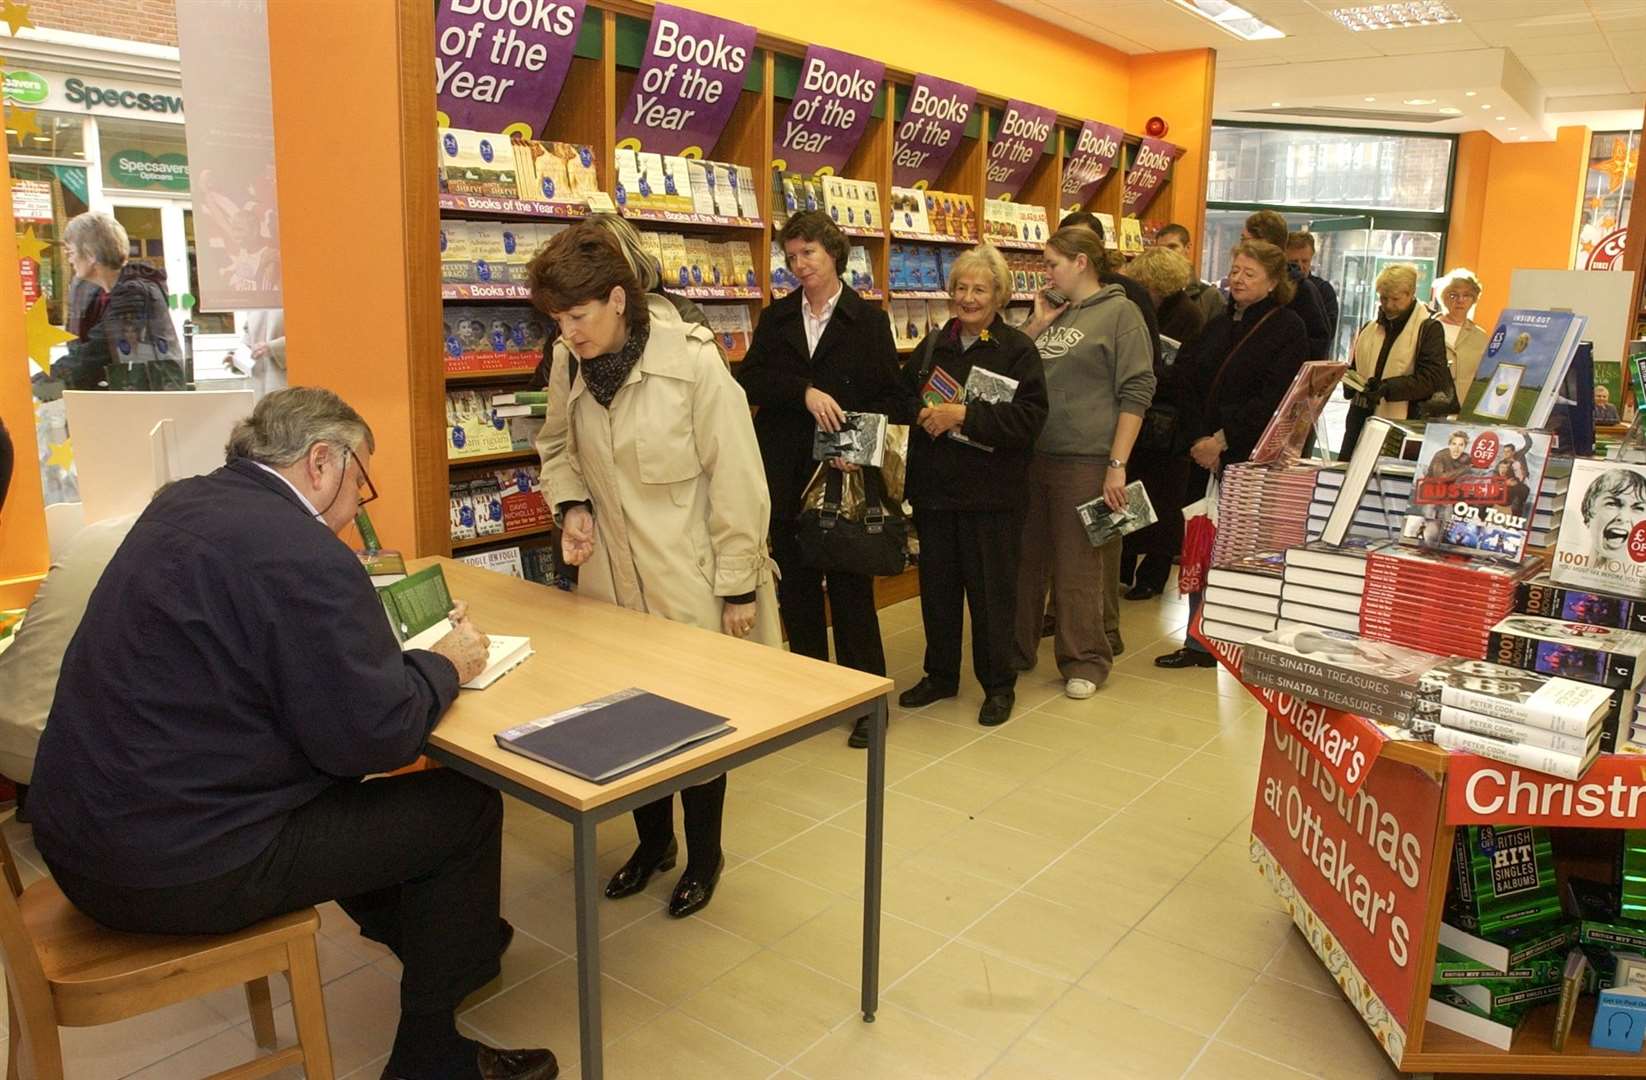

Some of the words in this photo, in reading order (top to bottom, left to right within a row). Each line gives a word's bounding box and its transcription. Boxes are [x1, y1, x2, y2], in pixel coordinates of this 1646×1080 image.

[440, 22, 485, 58] of
[490, 29, 548, 71] the
[653, 19, 746, 73] Books
[435, 57, 514, 103] Year
[643, 63, 678, 94] of
[678, 68, 722, 103] the
[804, 58, 876, 102] Books
[65, 78, 184, 113] Specsav
[910, 85, 969, 124] Books
[633, 94, 695, 130] Year
[793, 96, 822, 121] of
[821, 99, 855, 129] the
[1002, 109, 1049, 142] Books
[782, 121, 832, 152] Year
[900, 118, 925, 141] of
[921, 121, 951, 147] the
[1078, 129, 1117, 158] Books
[892, 141, 930, 168] Year
[992, 138, 1013, 158] of
[1009, 140, 1033, 163] the
[1136, 145, 1170, 171] Books
[985, 159, 1015, 183] Year
[1067, 155, 1087, 177] of
[1085, 156, 1103, 180] the
[1127, 168, 1144, 185] of
[1140, 169, 1157, 189] the
[468, 197, 502, 210] Books
[503, 200, 514, 210] of
[516, 201, 532, 212] the
[534, 203, 554, 214] Year
[471, 285, 502, 296] Books
[506, 286, 516, 296] of
[1473, 451, 1495, 460] OFF
[1477, 439, 1495, 452] £2
[1454, 502, 1479, 517] On
[1485, 507, 1527, 529] Tour
[1559, 552, 1589, 567] 1001
[1526, 585, 1543, 614] 1001
[1498, 634, 1515, 664] 1001
[1257, 652, 1278, 665] THE
[1279, 657, 1323, 677] SINATRA
[1326, 669, 1390, 695] TREASURES
[1255, 671, 1275, 684] THE
[1277, 677, 1320, 697] SINATRA
[1322, 690, 1383, 716] TREASURES
[1470, 699, 1493, 709] PETER
[1495, 704, 1514, 714] COOK
[1470, 719, 1493, 729] PETER
[1495, 724, 1514, 734] COOK
[1462, 740, 1485, 750] PETER
[1487, 745, 1506, 755] COOK
[1273, 719, 1421, 888] Cstmas
[1498, 831, 1530, 849] RITISH
[1494, 844, 1532, 868] HIT
[1264, 776, 1283, 817] at
[1286, 784, 1410, 967] Ottakar's
[1495, 863, 1534, 881] SINGLES
